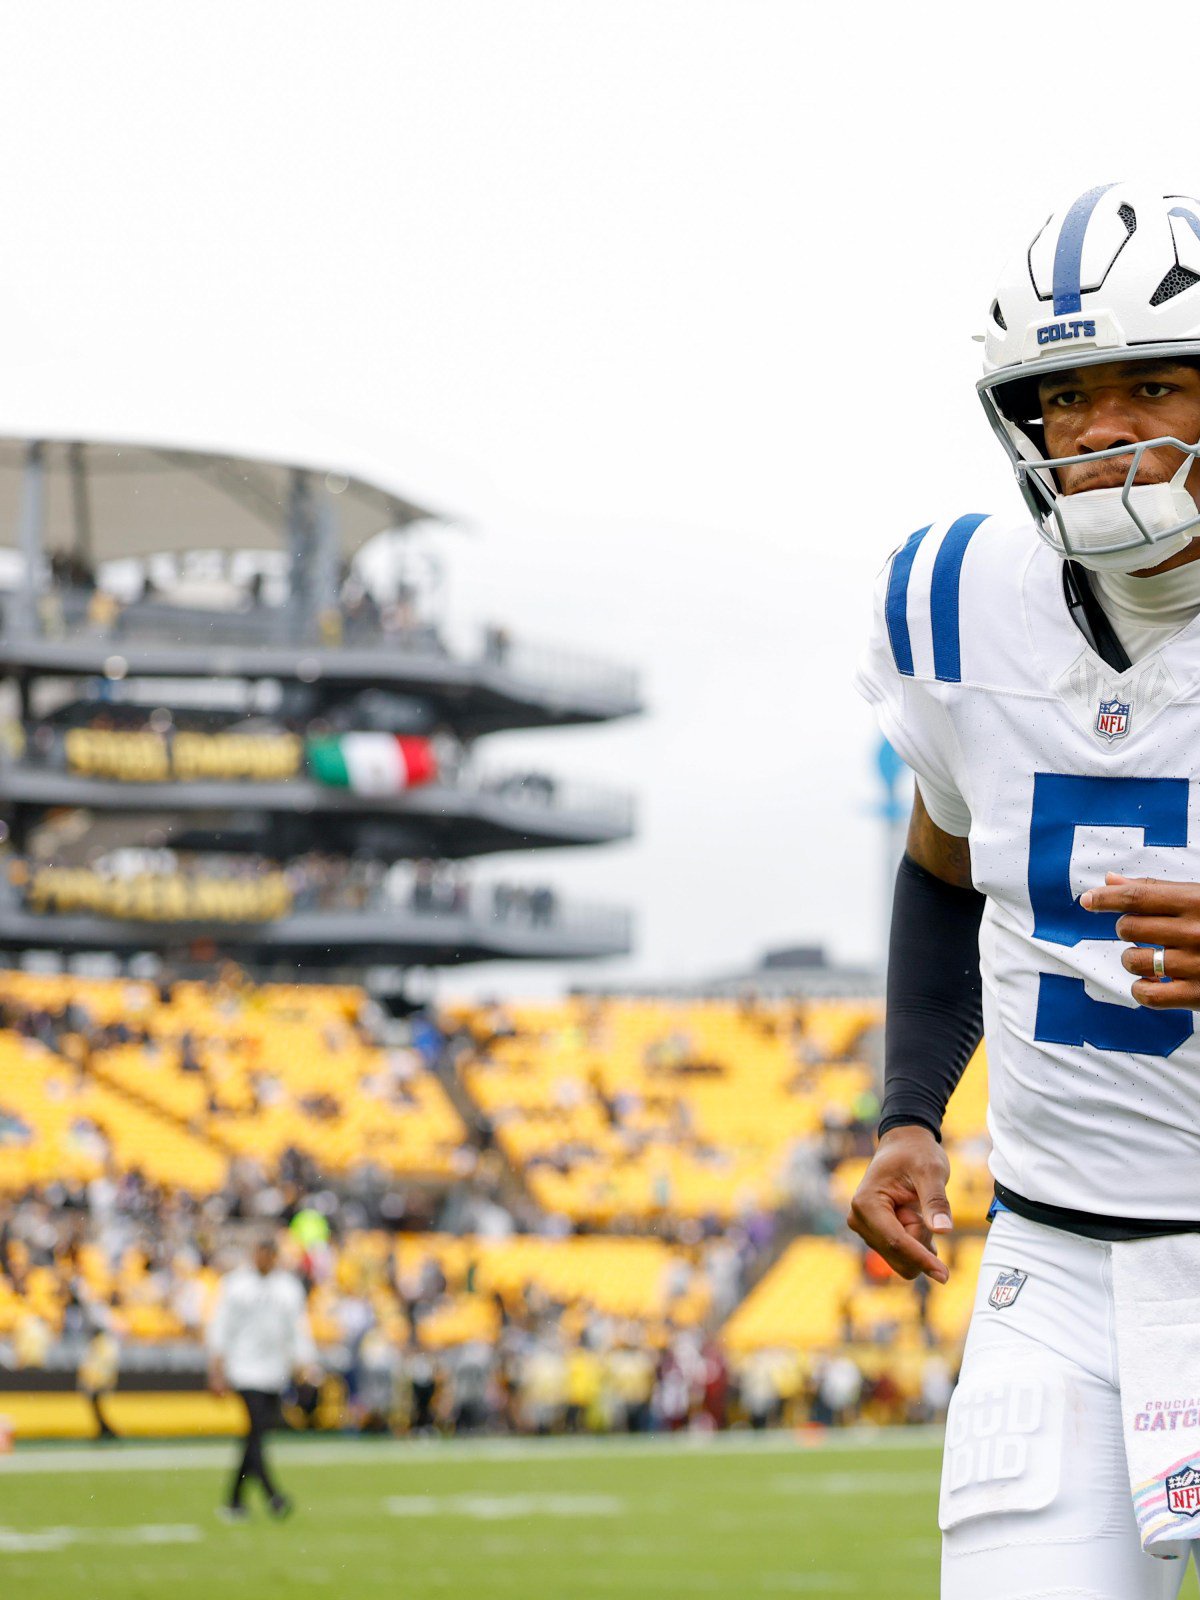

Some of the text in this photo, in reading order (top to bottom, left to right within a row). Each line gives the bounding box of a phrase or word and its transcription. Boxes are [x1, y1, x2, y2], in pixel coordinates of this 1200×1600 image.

[1037, 320, 1096, 344] COLTS
[1099, 714, 1124, 734] NFL
[1028, 771, 1194, 1058] 5
[992, 1286, 1014, 1303] NFL
